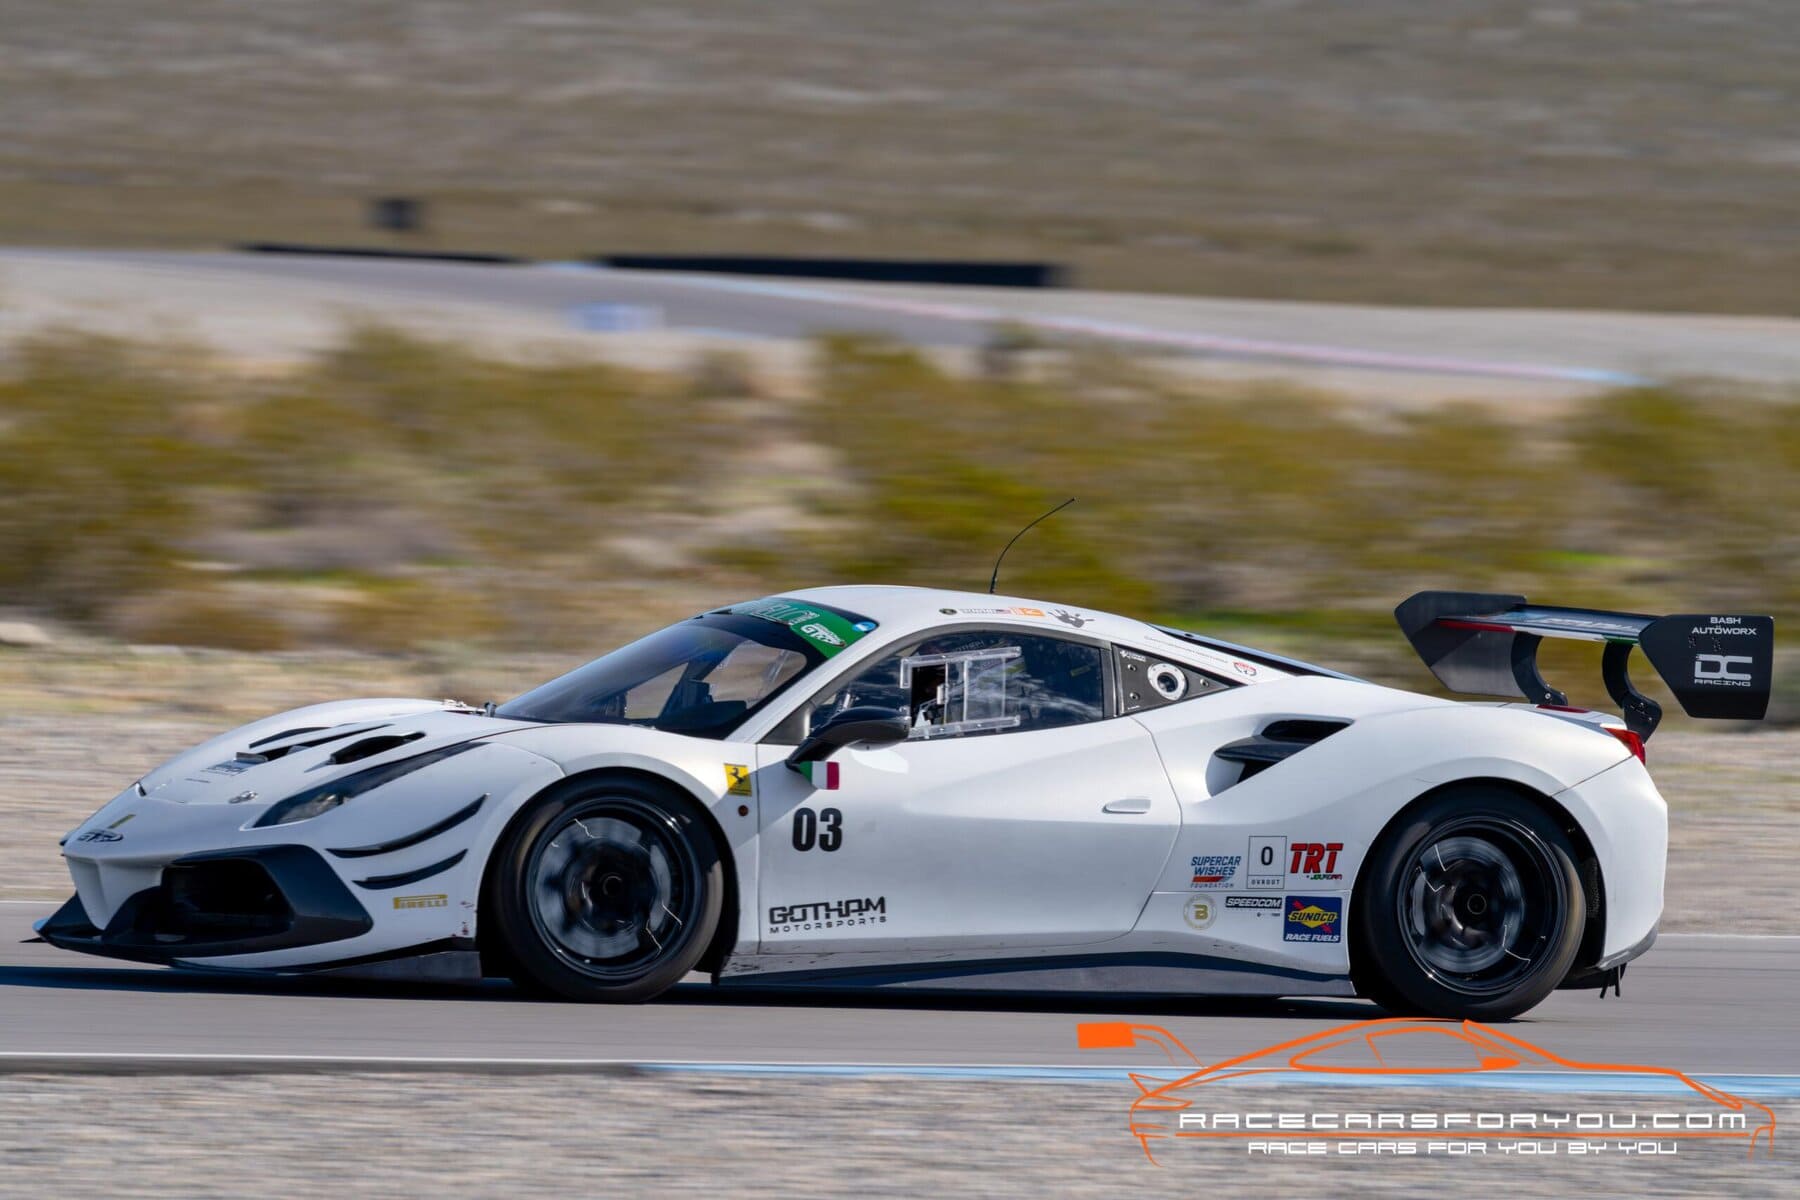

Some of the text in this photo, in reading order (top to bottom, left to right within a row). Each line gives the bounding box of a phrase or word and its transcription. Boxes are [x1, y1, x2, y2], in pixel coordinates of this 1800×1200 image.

[1710, 616, 1742, 625] BASH
[1694, 653, 1753, 681] DC
[1694, 678, 1752, 687] RACING
[792, 807, 843, 852] 03
[1190, 855, 1242, 867] SUPERCAR
[1290, 843, 1344, 874] TRT
[1194, 866, 1236, 876] WISHES
[1226, 897, 1282, 908] SPEEDCOM
[769, 896, 886, 925] GOTHAM
[1290, 911, 1337, 922] SUNOCO
[769, 916, 887, 934] MOTORSPORTS
[1285, 933, 1340, 942] RACE FUELS
